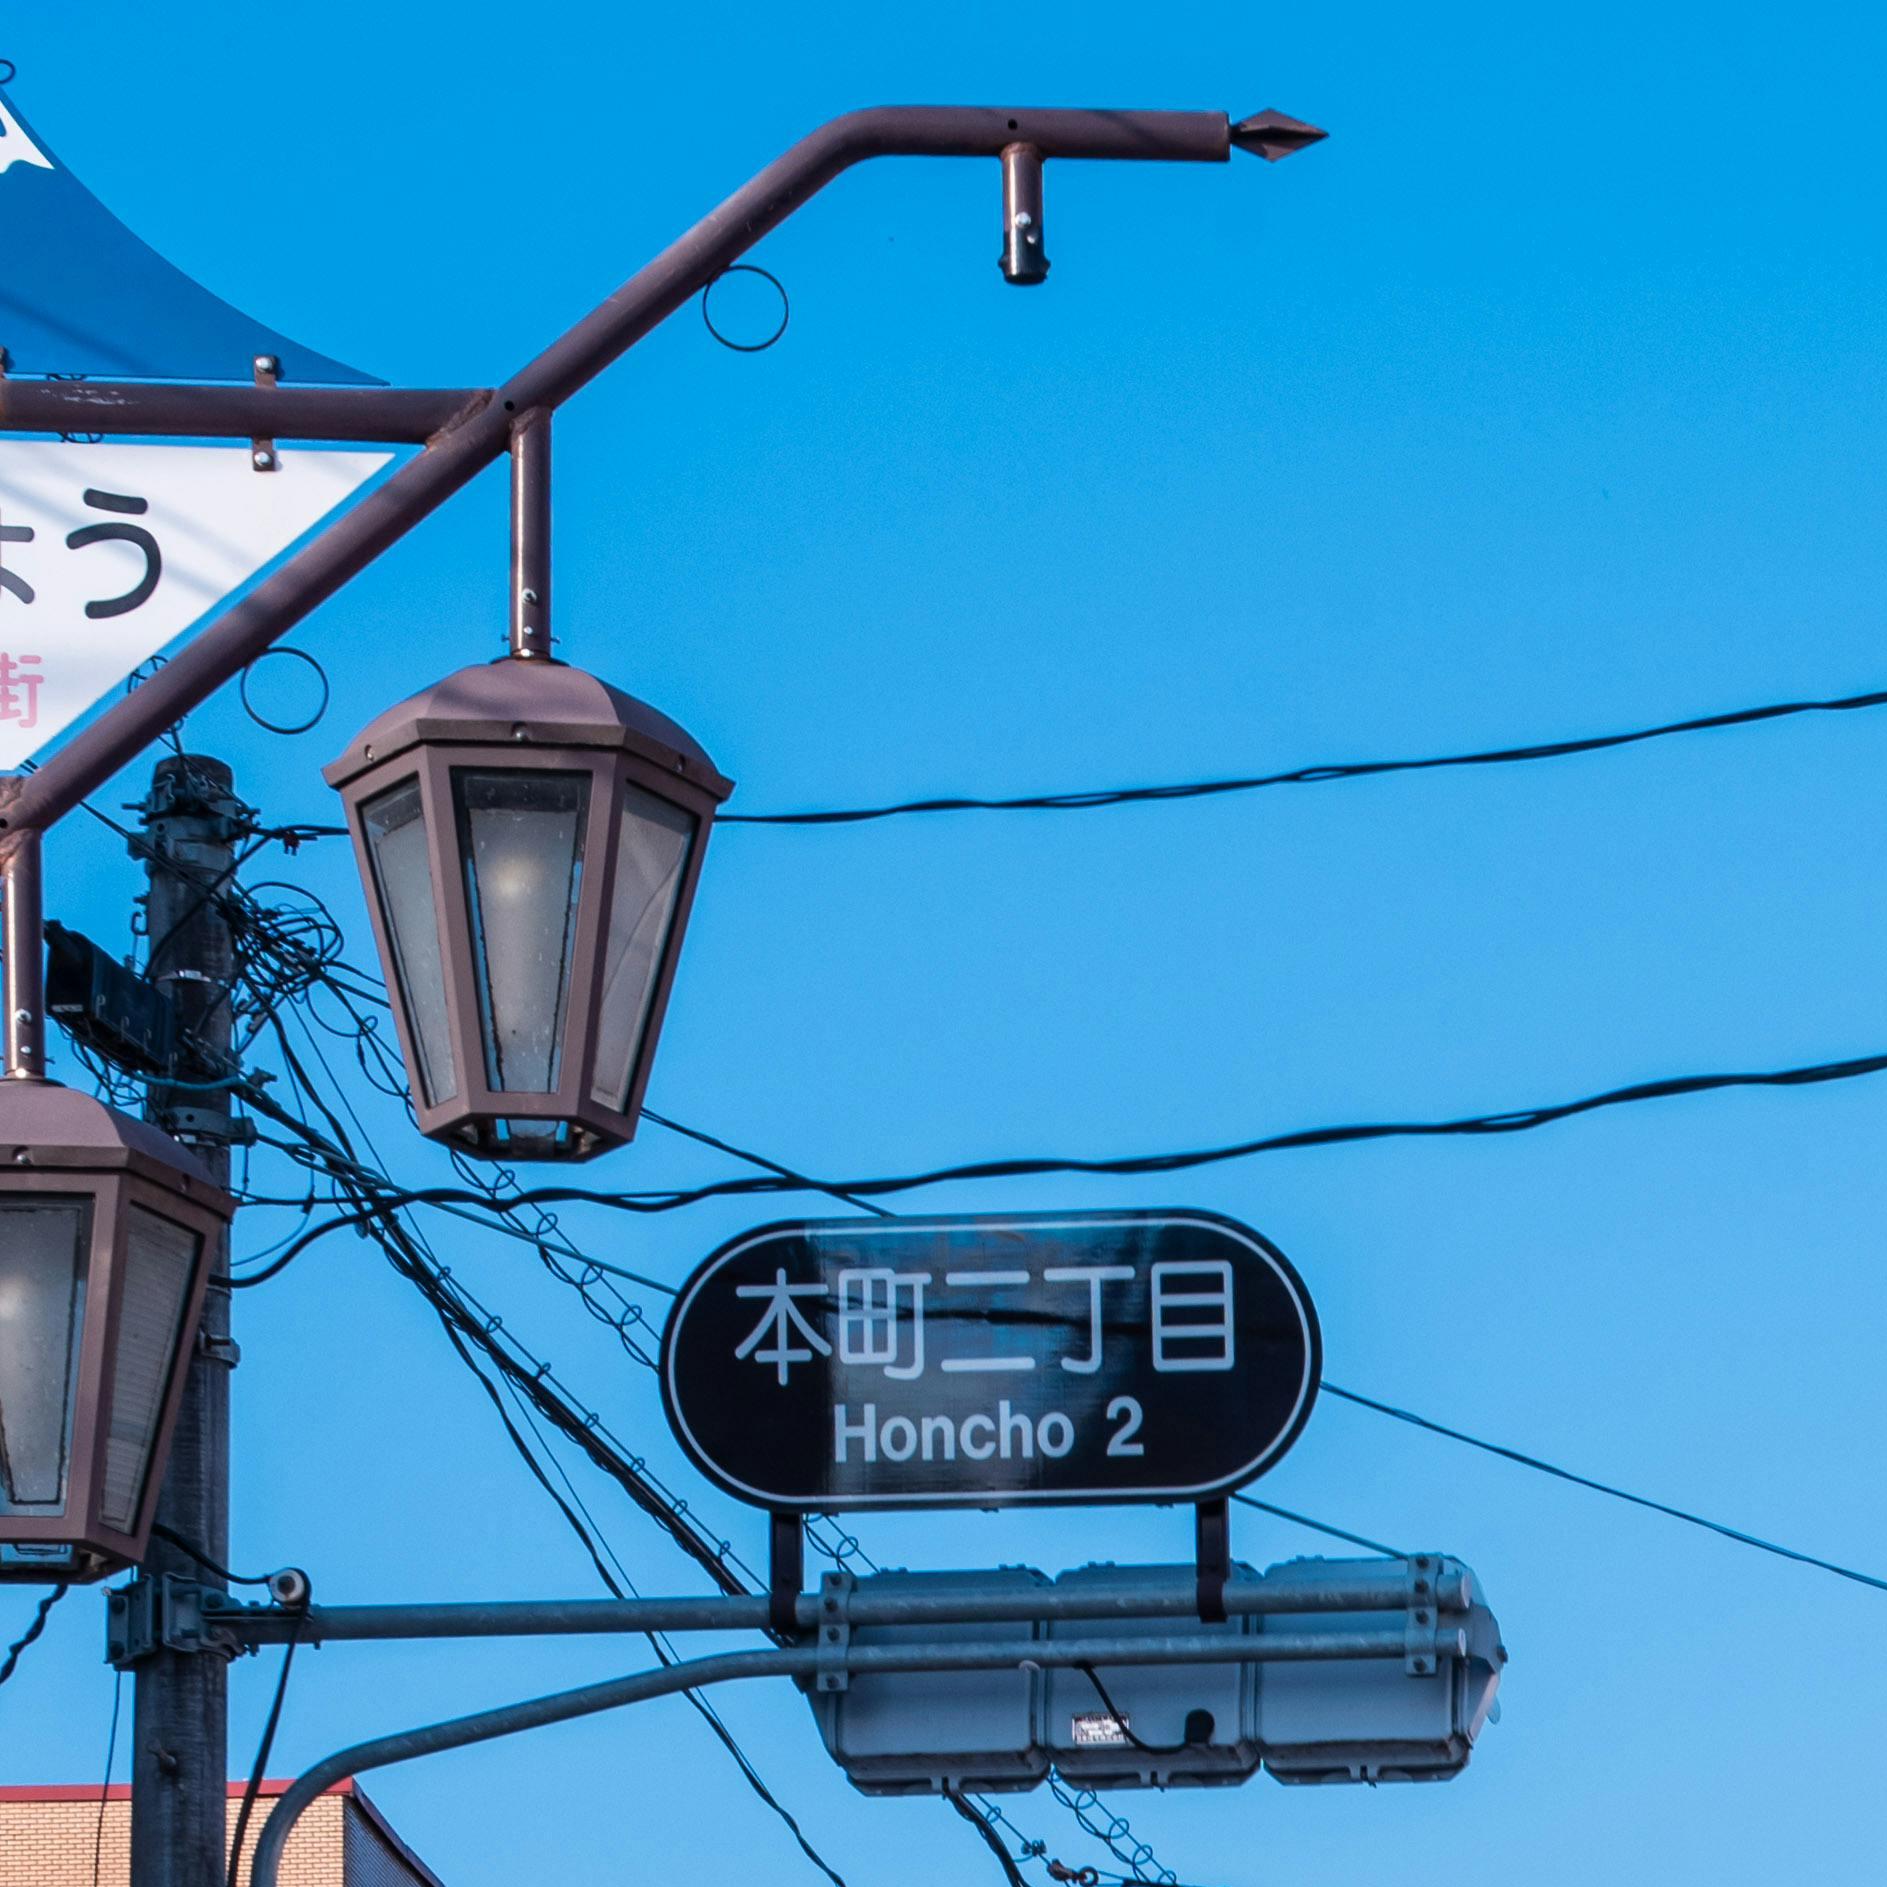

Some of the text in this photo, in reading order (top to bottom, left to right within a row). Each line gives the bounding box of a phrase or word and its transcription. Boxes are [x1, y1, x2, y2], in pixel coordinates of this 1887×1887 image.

[735, 1260, 1237, 1387] 本町二丁目
[833, 1396, 1146, 1465] Honcho 2
